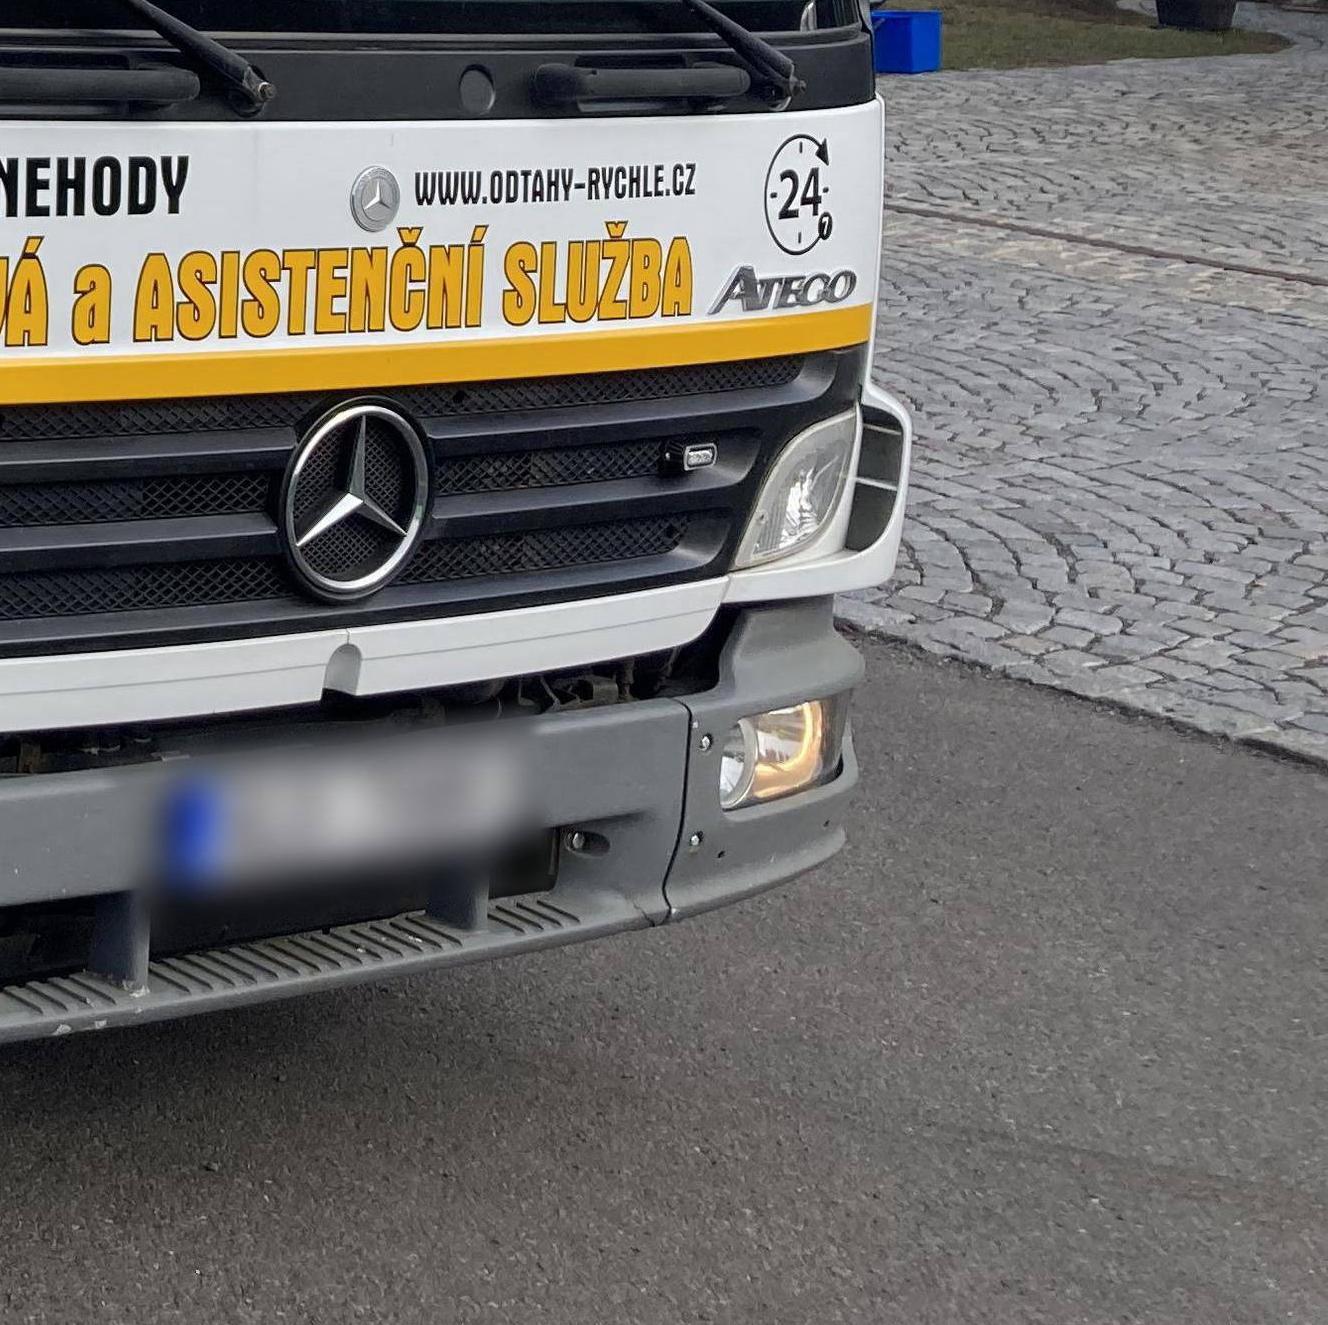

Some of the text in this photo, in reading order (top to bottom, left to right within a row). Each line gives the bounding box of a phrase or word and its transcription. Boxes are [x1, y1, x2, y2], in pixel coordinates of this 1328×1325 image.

[414, 162, 697, 206] WWW.ODTAHY-RYCHLE.CZ
[778, 167, 822, 220] 24
[71, 263, 113, 346] a
[133, 221, 489, 343] ASISTENČNÍ
[502, 221, 693, 327] SLUŽBA
